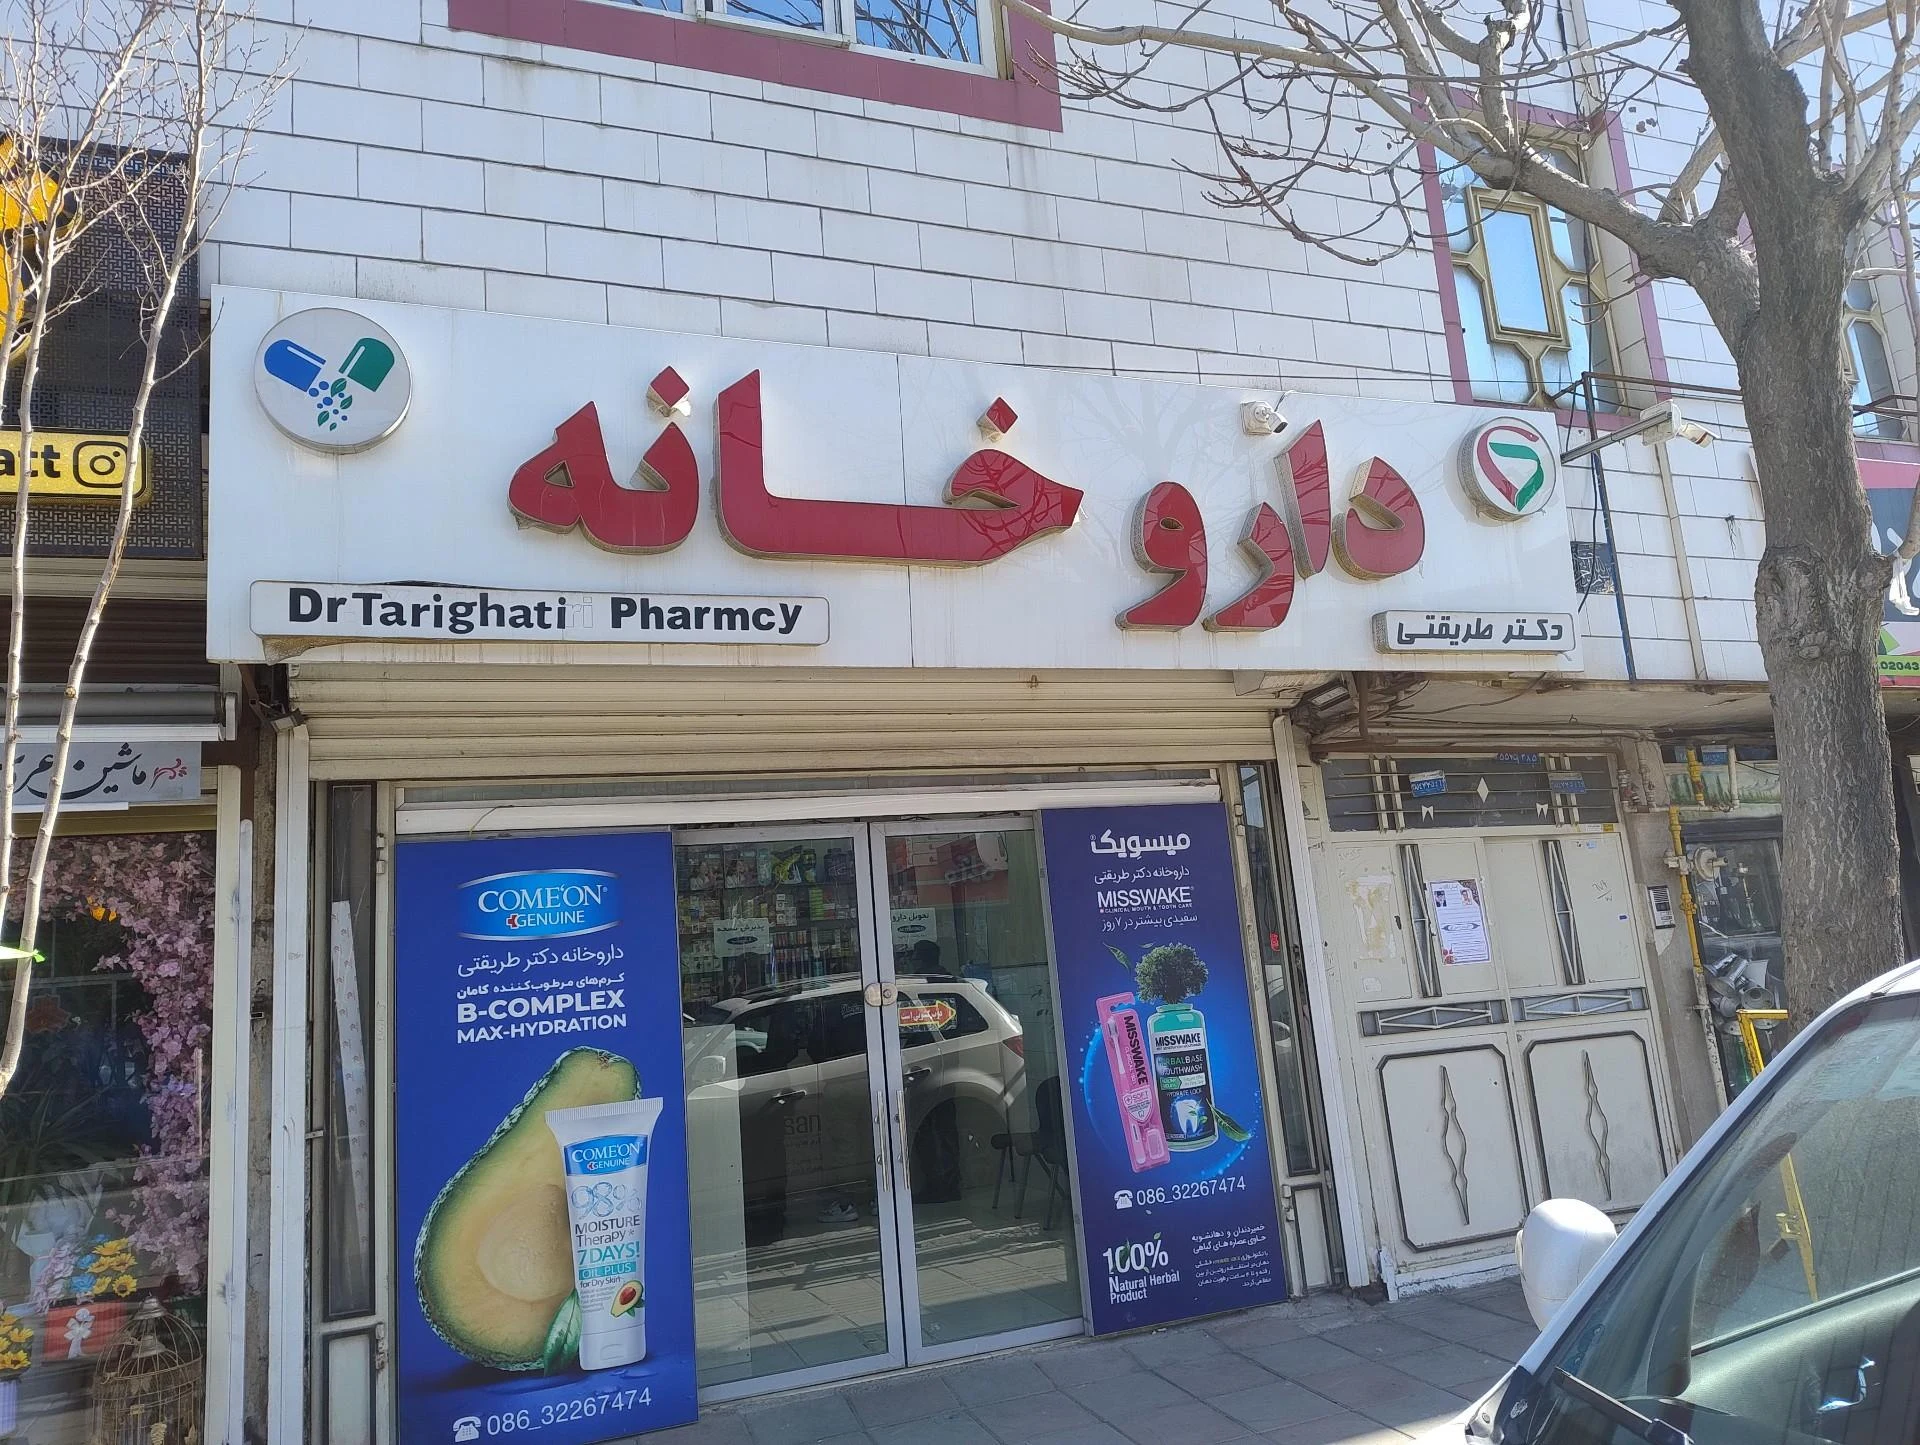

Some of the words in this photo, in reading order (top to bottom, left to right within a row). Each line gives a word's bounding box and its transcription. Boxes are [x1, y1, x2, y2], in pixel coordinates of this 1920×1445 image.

[289, 587, 346, 624] Dr
[351, 592, 567, 634] Tarighati
[611, 596, 803, 635] Pharmcy
[1397, 614, 1494, 646] طریقتی
[1502, 618, 1563, 644] دکتر
[1094, 869, 1130, 885] طریقتی
[1132, 867, 1151, 883] دکتر
[1153, 865, 1190, 881] داروخانه
[1097, 886, 1192, 908] MISSWAKE
[516, 910, 585, 928] GENUINE
[1134, 914, 1163, 930] بیشتر
[1163, 912, 1198, 928] سفیدی
[458, 952, 521, 977] طریقتی
[523, 948, 559, 972] دکتر
[562, 944, 624, 966] داروخانه
[457, 984, 490, 1000] کامان
[457, 989, 626, 1024] B-COMPLEX
[457, 1013, 627, 1044] MAX-HYDRATION
[1124, 1015, 1149, 1085] MISSWAKE
[1155, 1033, 1201, 1047] MISSWAKE
[593, 1158, 629, 1169] GENUINE
[1137, 1176, 1246, 1206] 086_32267474
[575, 1215, 641, 1236] MOISTURE
[576, 1228, 626, 1248] Therapy
[1103, 1239, 1169, 1275] 100%
[583, 1266, 602, 1279] OIL
[604, 1262, 632, 1276] PLUS
[580, 1280, 591, 1288] for
[592, 1278, 605, 1288] Dry
[1109, 1275, 1147, 1293] Natural
[1149, 1271, 1180, 1287] Herbal
[1110, 1288, 1148, 1304] Product
[487, 1387, 652, 1436] 086_32267474
